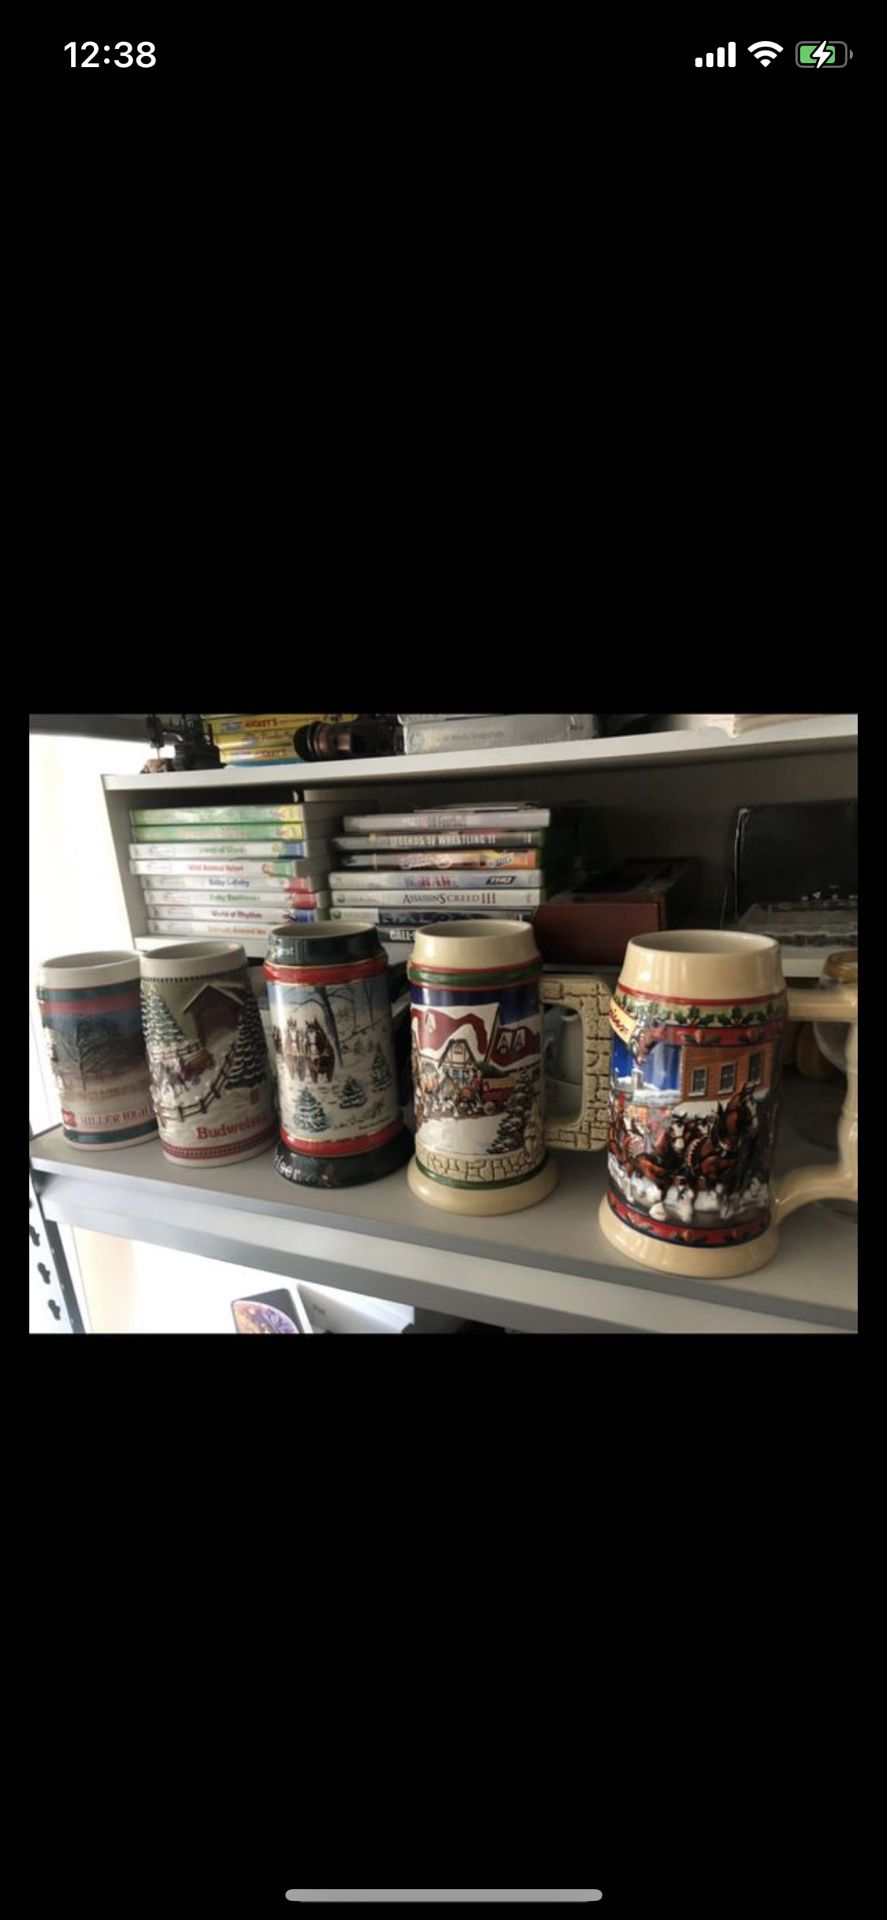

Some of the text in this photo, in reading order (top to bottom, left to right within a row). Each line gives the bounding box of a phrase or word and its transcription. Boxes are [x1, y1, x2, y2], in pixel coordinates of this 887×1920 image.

[438, 834, 486, 844] WRESTLING
[447, 894, 480, 902] CREED
[481, 893, 496, 904] III
[80, 1113, 120, 1125] MILLER
